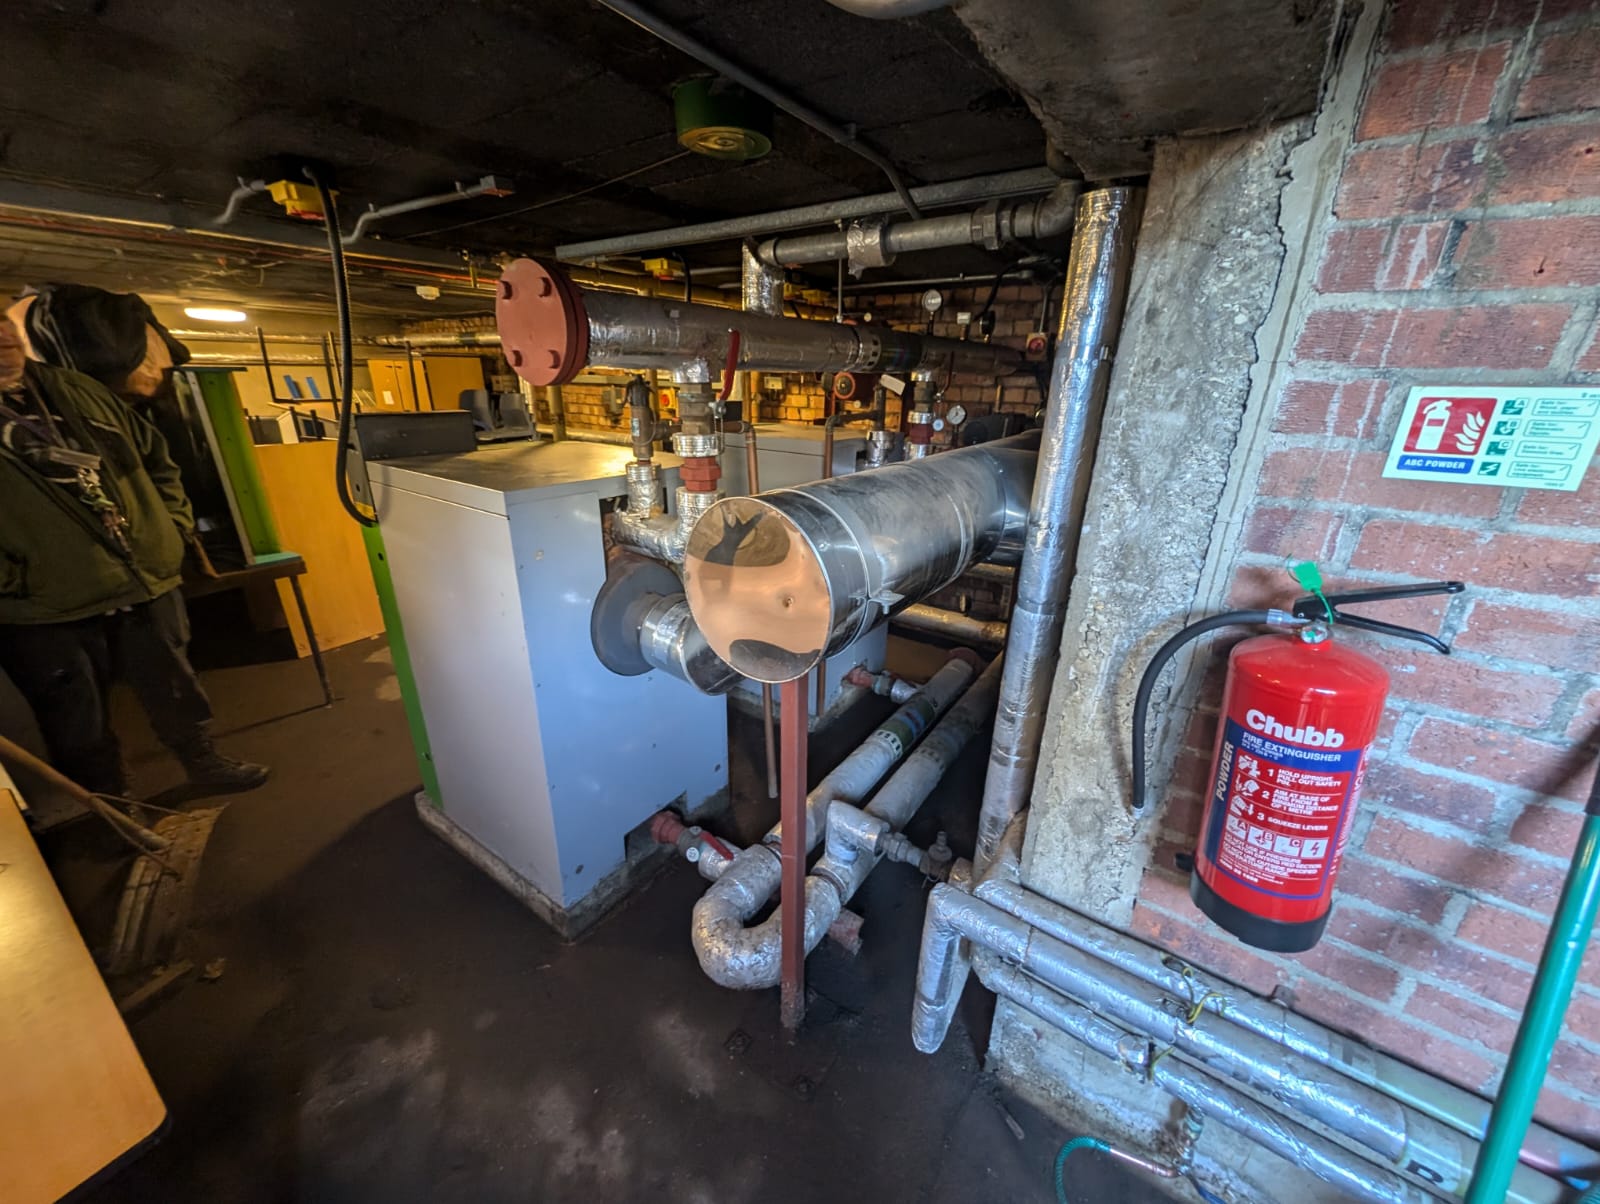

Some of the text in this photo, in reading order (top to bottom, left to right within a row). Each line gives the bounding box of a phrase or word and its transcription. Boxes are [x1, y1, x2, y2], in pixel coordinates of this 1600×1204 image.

[1404, 458, 1466, 470] ABC POWDER
[1246, 709, 1344, 748] Chubb
[1243, 732, 1263, 745] FIRE
[1264, 742, 1342, 762] EXTINGUISHER
[1216, 741, 1234, 801] POWDER
[1267, 769, 1274, 777] 1
[1278, 769, 1300, 779] HOLD
[1315, 780, 1342, 788] SAFETY
[1261, 790, 1270, 799] 2
[1257, 812, 1265, 821] 3
[1239, 821, 1246, 829] A
[1264, 832, 1272, 840] B
[1291, 839, 1300, 847] C
